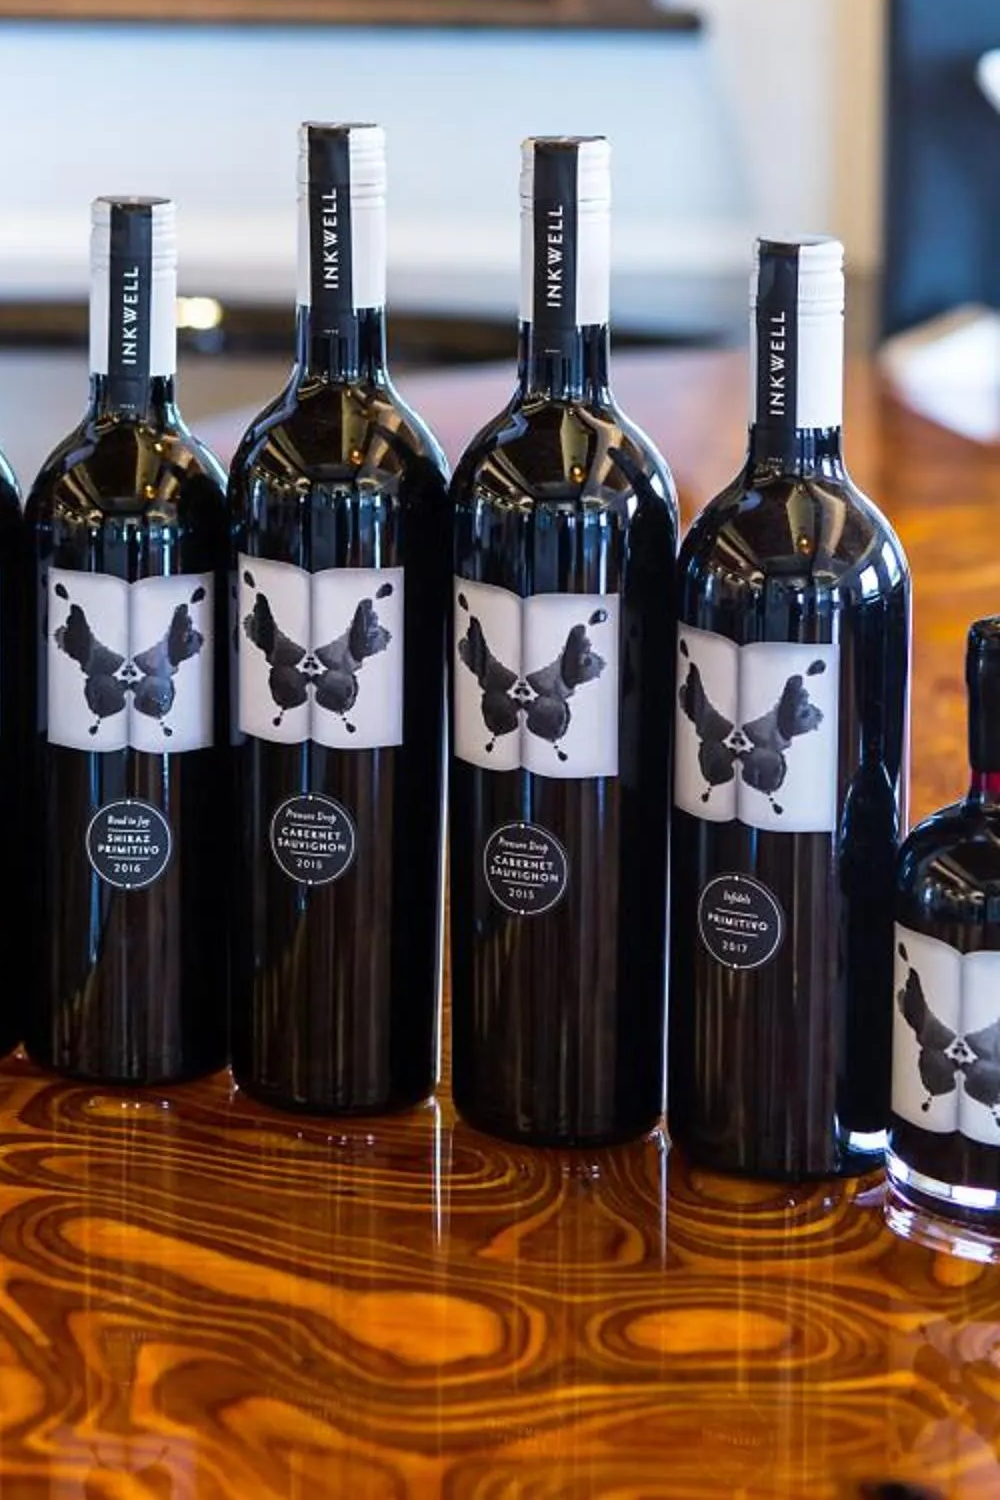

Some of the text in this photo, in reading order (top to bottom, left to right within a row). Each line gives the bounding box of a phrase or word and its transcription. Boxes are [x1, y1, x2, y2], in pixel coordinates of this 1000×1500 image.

[321, 187, 339, 289] INKWELL
[546, 204, 564, 308] INKWELL
[121, 265, 140, 365] INKWELL
[769, 311, 787, 416] INKWELL
[107, 833, 151, 843] SHIRAZ
[281, 827, 341, 841] CABERNET
[97, 844, 160, 855] PRIMITIVO
[277, 836, 347, 853] SAUVIGNON
[113, 863, 141, 873] 2016
[493, 855, 554, 871] CABERNET
[489, 865, 560, 883] SAUVIGNON
[707, 912, 769, 931] PRIMITIVO
